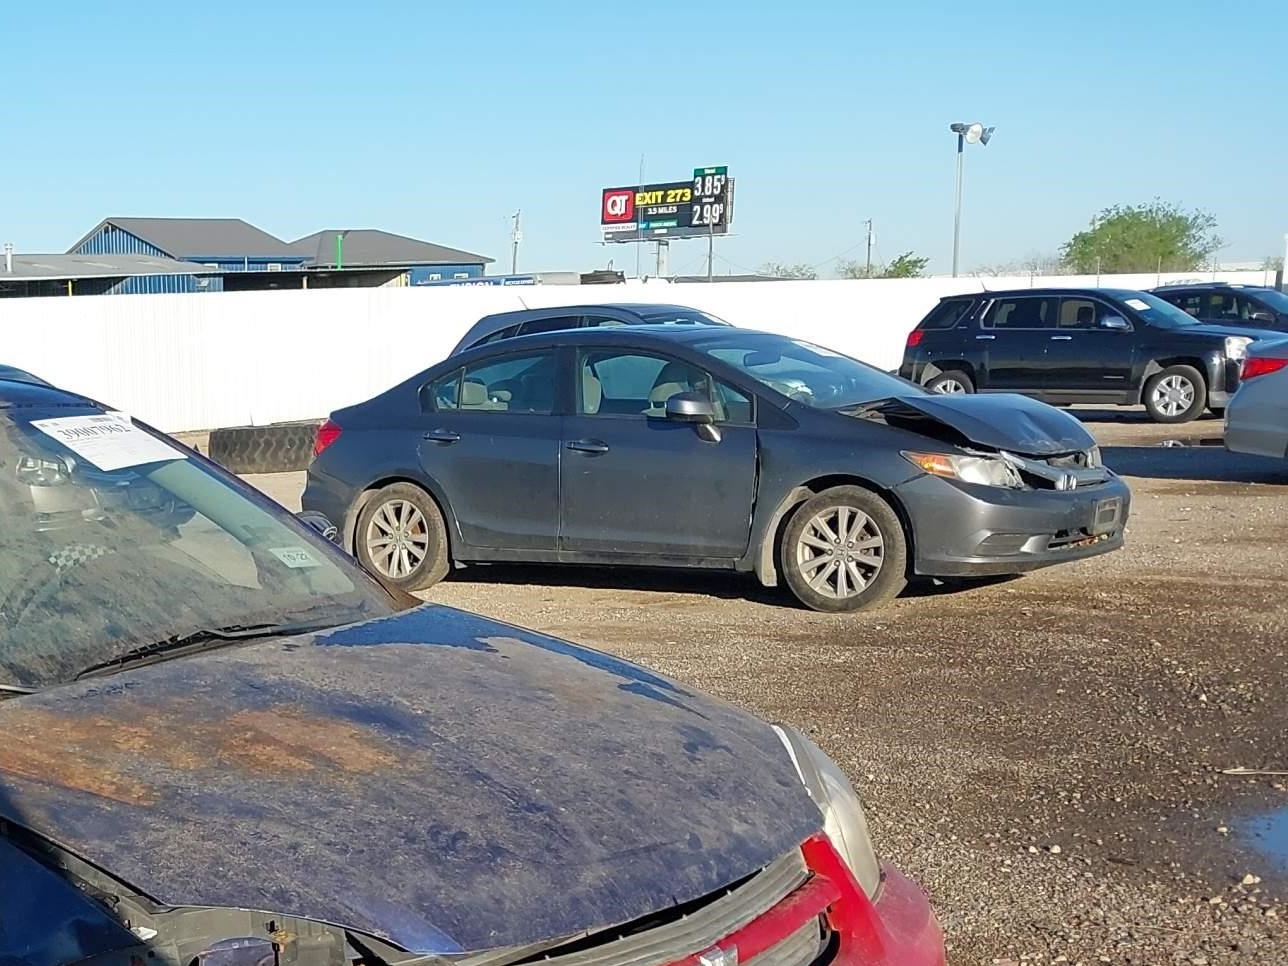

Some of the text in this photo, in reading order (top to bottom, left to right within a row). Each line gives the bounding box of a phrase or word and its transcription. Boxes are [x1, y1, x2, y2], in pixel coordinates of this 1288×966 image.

[635, 191, 665, 205] EXIT
[666, 189, 691, 203] 273
[607, 195, 629, 216] QT
[658, 206, 678, 215] MILES
